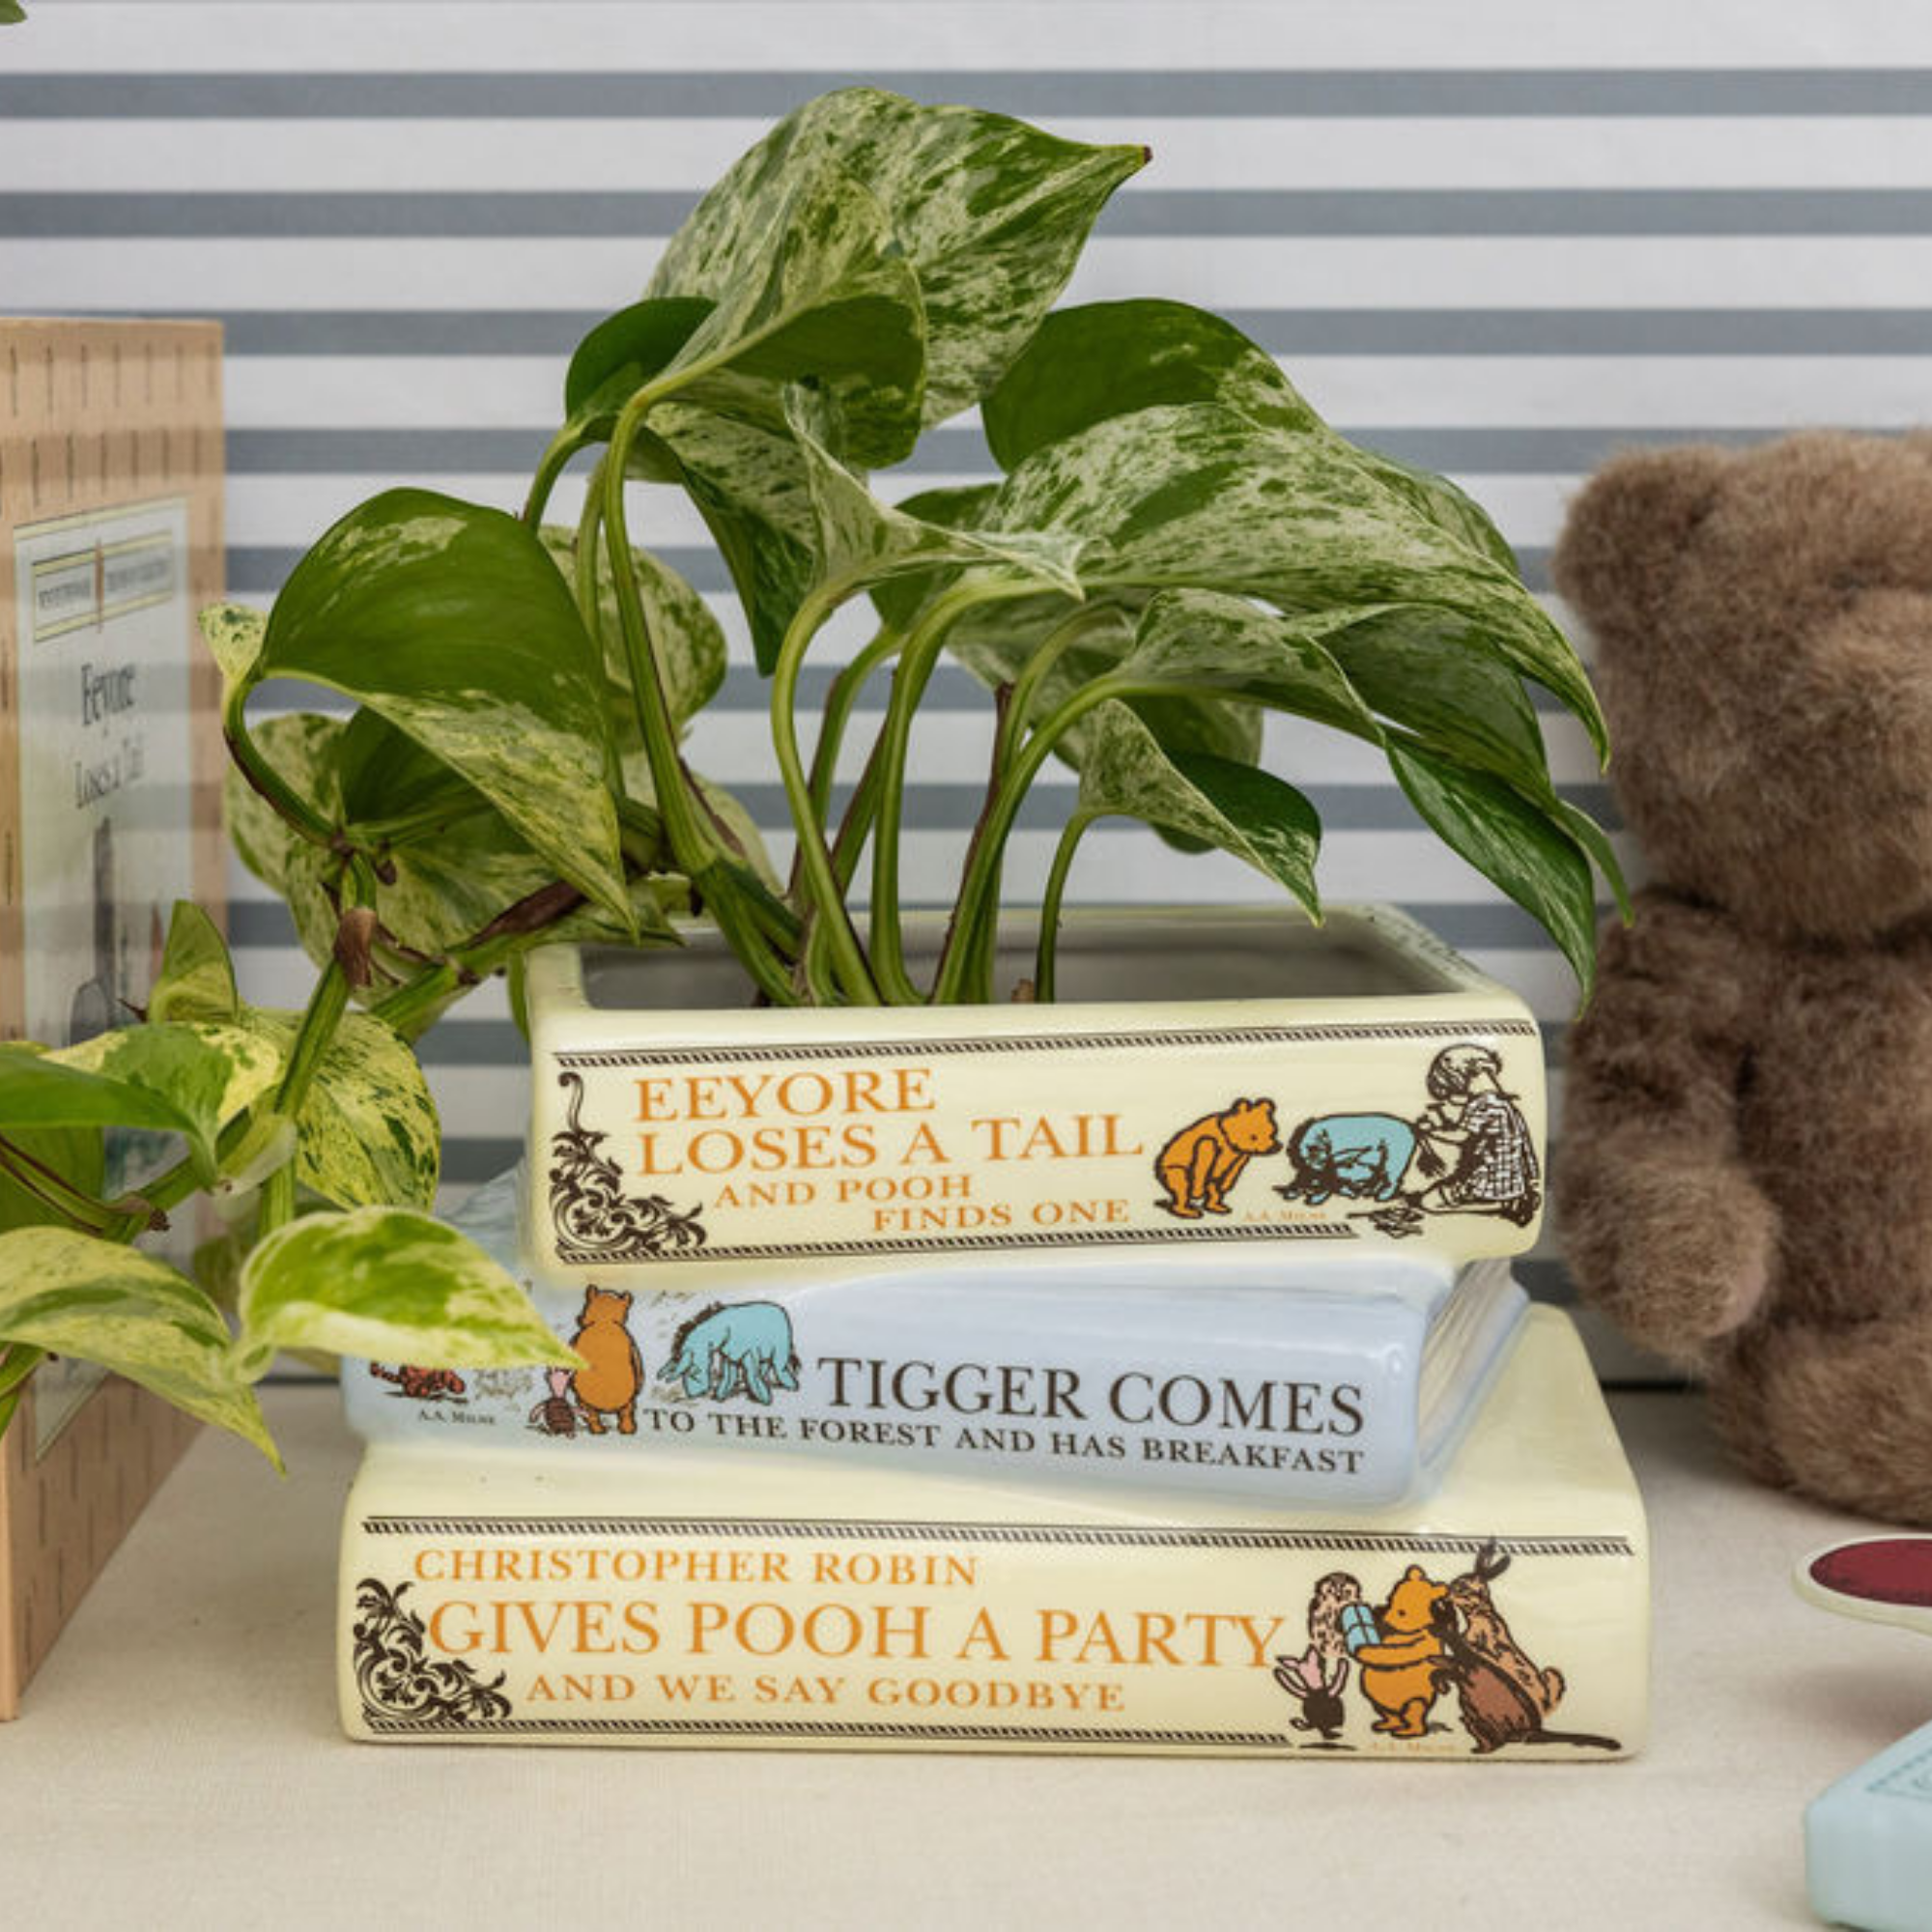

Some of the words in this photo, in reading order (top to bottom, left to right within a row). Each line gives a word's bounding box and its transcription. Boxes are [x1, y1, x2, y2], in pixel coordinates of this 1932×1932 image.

[633, 1066, 938, 1123] EEYORE
[636, 1122, 878, 1178] LOSES
[901, 1121, 952, 1168] A
[970, 1113, 1144, 1163] TAIL
[714, 1179, 816, 1210] AND
[837, 1175, 973, 1206] POOH
[872, 1205, 1013, 1234] FINDS
[1032, 1199, 1130, 1225] ONE
[817, 1357, 1089, 1420] TIGGER
[1109, 1373, 1365, 1436] COMES
[643, 1407, 696, 1433] TO
[706, 1411, 787, 1439] THE
[800, 1417, 941, 1449] FOREST
[955, 1428, 1037, 1453] AND
[1050, 1432, 1127, 1459] HAS
[1143, 1436, 1365, 1475] BREAKFAST
[412, 1547, 793, 1586] CHRISTOPHER
[813, 1551, 978, 1587] ROBIN
[426, 1599, 662, 1657] GIVES
[686, 1600, 931, 1662] POOH
[955, 1606, 1011, 1662] A
[1034, 1608, 1286, 1670] PARTY
[526, 1673, 638, 1704] AND
[655, 1674, 736, 1706] WE
[753, 1675, 847, 1707] SAY
[867, 1676, 1125, 1714] GOODBYE
